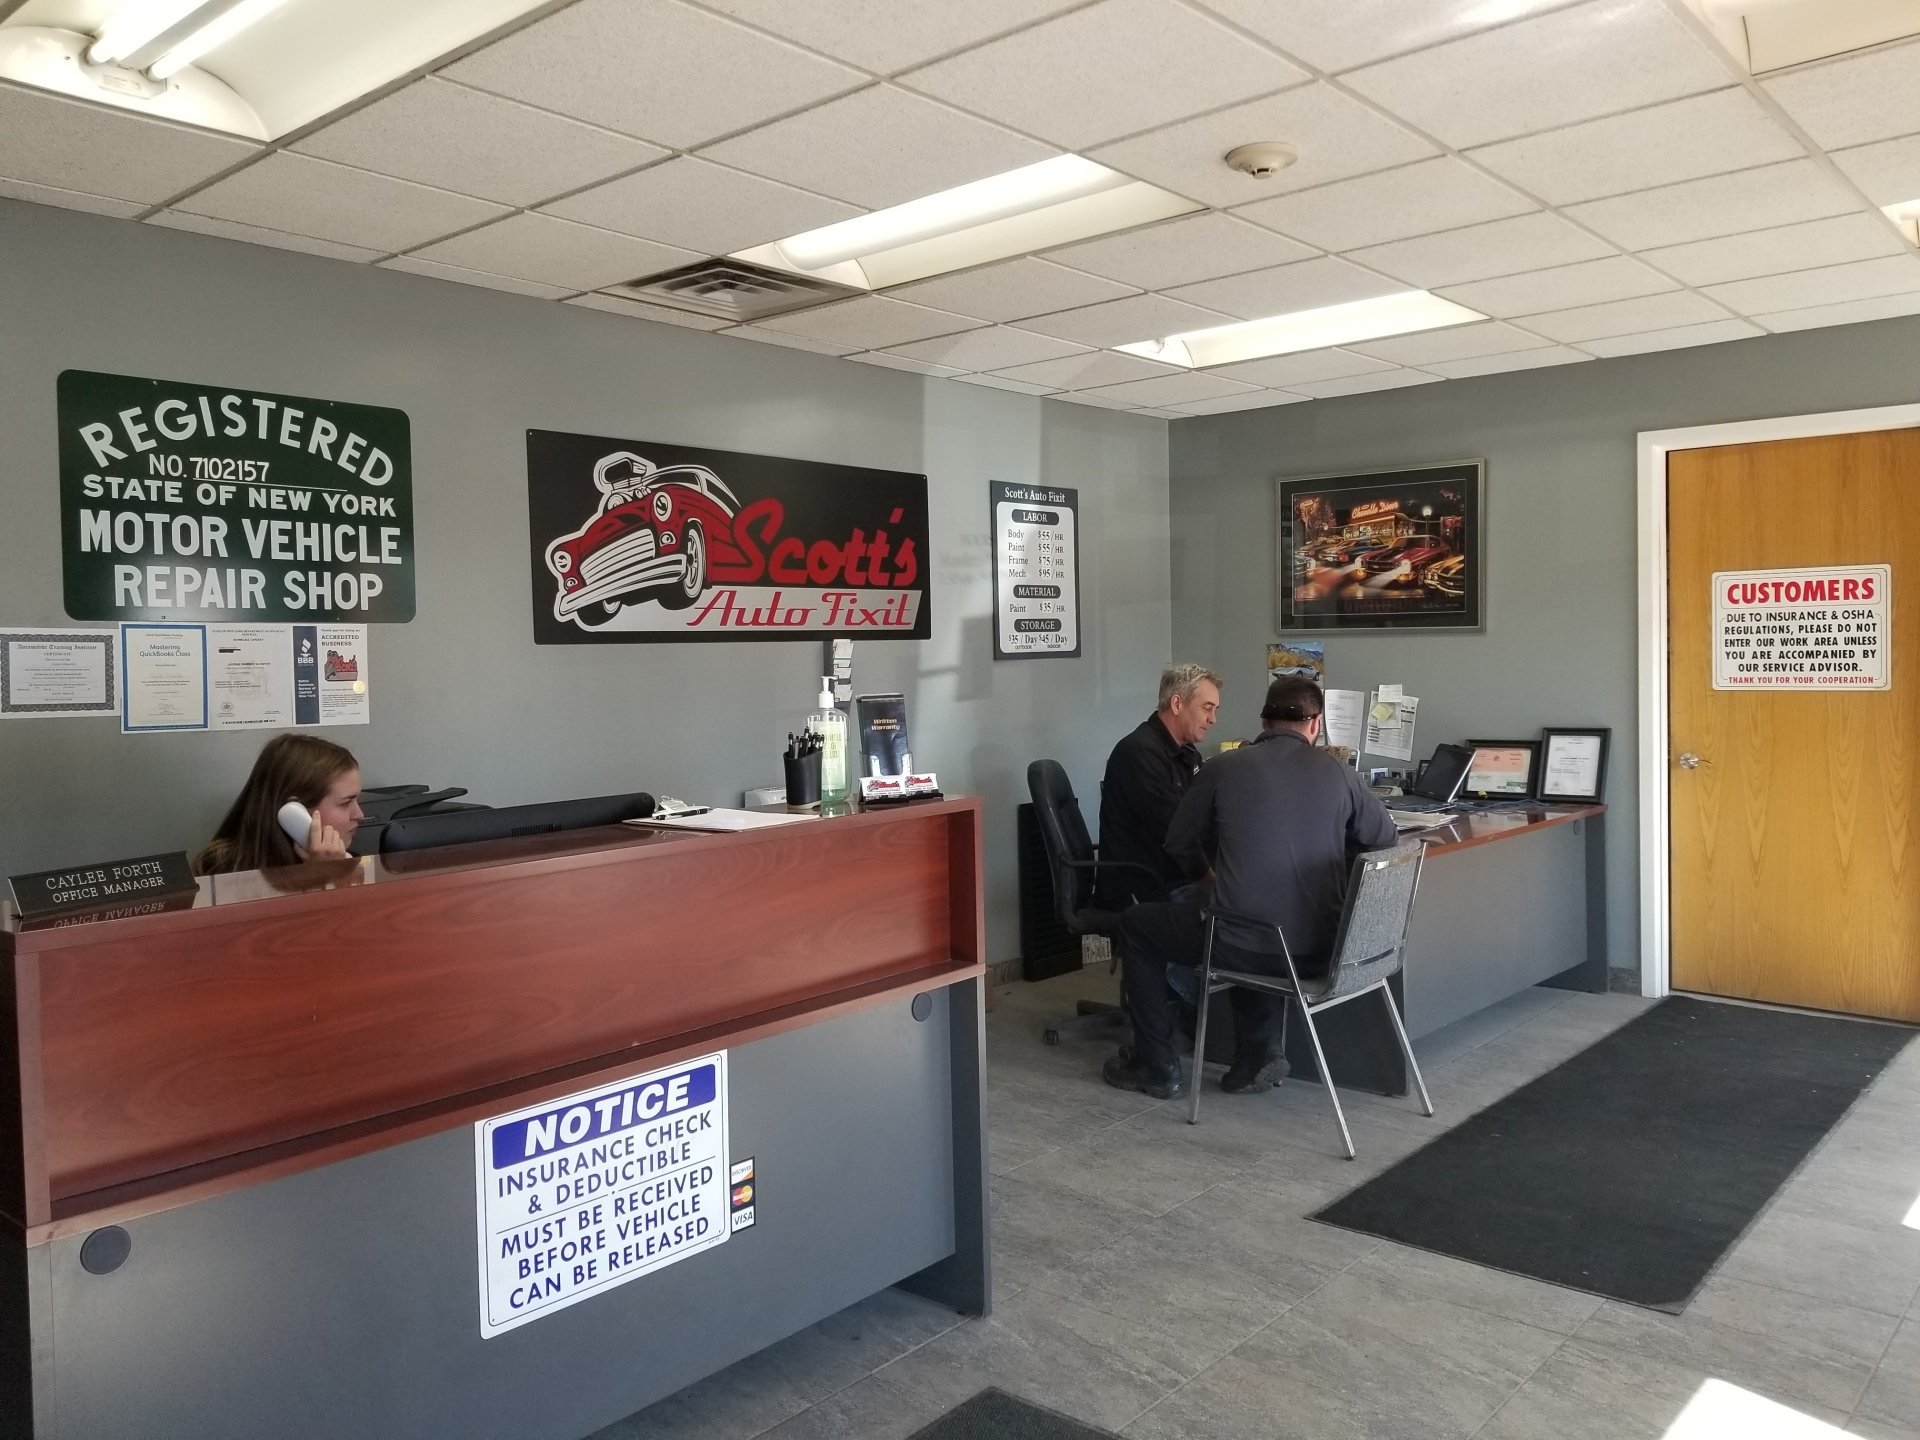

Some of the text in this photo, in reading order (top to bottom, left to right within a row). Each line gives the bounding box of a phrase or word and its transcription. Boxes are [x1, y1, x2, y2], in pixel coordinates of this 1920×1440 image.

[79, 395, 393, 486] REGISTERED
[149, 454, 270, 482] NO. 7102157
[83, 474, 396, 517] STATE OF NEW YORK
[1005, 487, 1065, 503] Scott's Auto Fixit
[1023, 512, 1048, 522] LABOR
[80, 509, 402, 565] MOTOR VEHICLE
[711, 498, 918, 587] Scott's
[1008, 529, 1024, 541] Body
[1009, 542, 1024, 551] Paint
[1009, 556, 1028, 564] Frame
[1009, 569, 1026, 577] Mech
[114, 565, 382, 611] REPAIR SHOP
[1018, 587, 1056, 596] MATERIAL
[1728, 578, 1874, 605] CUSTOMERS
[686, 590, 914, 628] Auto Fixit
[1010, 604, 1026, 612] Paint
[1727, 610, 1874, 622] DUE TO INSURANCE & OSHA
[1021, 621, 1055, 630] STORAGE
[1725, 623, 1877, 636] REGULATIONS, PLEASE DO NOT
[1056, 634, 1068, 645] Day
[1725, 636, 1877, 647] ENTER OUR WORK AREA UNLESS
[1725, 649, 1877, 660] YOU ARE ACCOMPANIED BY
[1738, 663, 1862, 672] OUR SERVICE ADVISOR.
[46, 861, 162, 890] CAYLEE FORTH
[53, 876, 165, 903] OFFICE MANAGER
[524, 1074, 691, 1157] NOTICE
[498, 1110, 712, 1198] INSURANCE CHECK
[528, 1141, 691, 1214] & DEDUCTIBLE
[501, 1166, 713, 1259] MUST BE RECEIVED
[734, 1211, 752, 1226] VISA
[518, 1193, 701, 1280] BEFORE VEHICLE
[510, 1216, 709, 1309] CAN BE RELEASED
